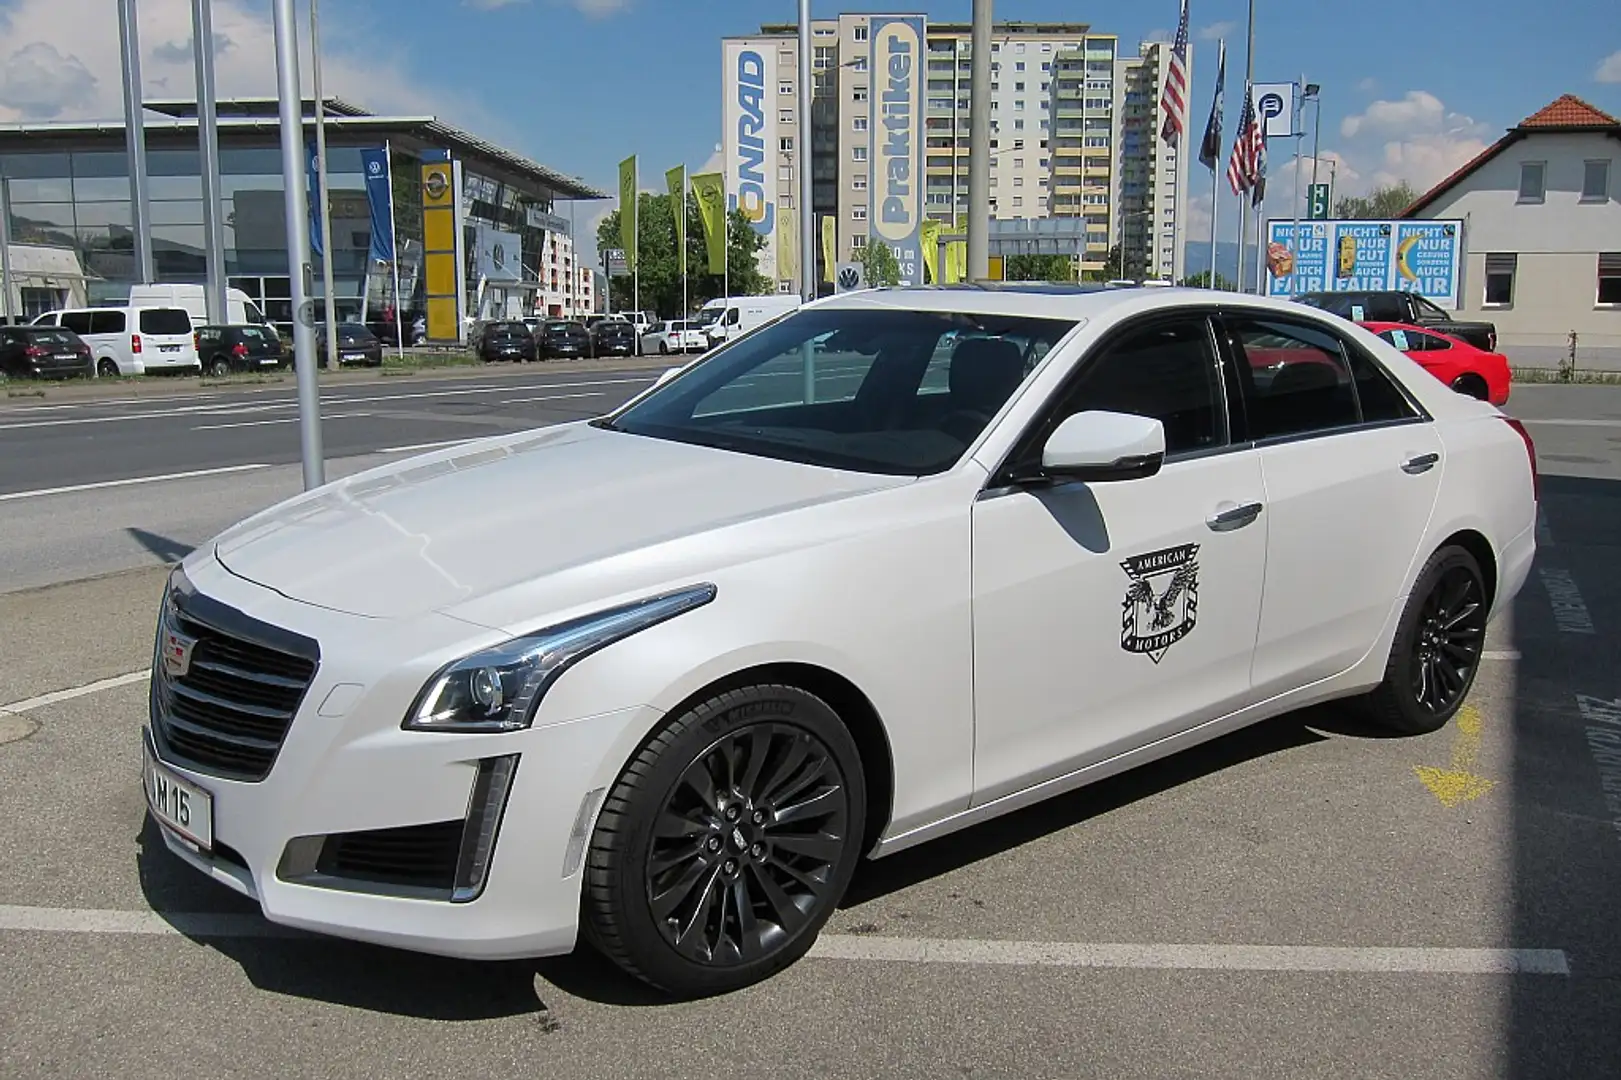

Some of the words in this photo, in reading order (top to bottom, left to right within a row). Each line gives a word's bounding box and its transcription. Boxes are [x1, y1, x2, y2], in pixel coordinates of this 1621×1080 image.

[882, 34, 912, 226] Praktiker
[728, 50, 775, 236] CONRAD
[1339, 227, 1379, 238] NICHT
[1402, 227, 1442, 238] NICHT
[1356, 238, 1386, 249] NUR
[1418, 239, 1450, 250] NUR
[1356, 250, 1386, 261] GUT
[1297, 266, 1323, 276] UCH
[1355, 267, 1385, 277] AUCH
[1416, 266, 1449, 277] AUCH
[1336, 276, 1384, 292] FAIR
[1398, 276, 1448, 294] FAIR
[1138, 549, 1186, 570] AMERICAN
[1135, 627, 1183, 651] MOTORS
